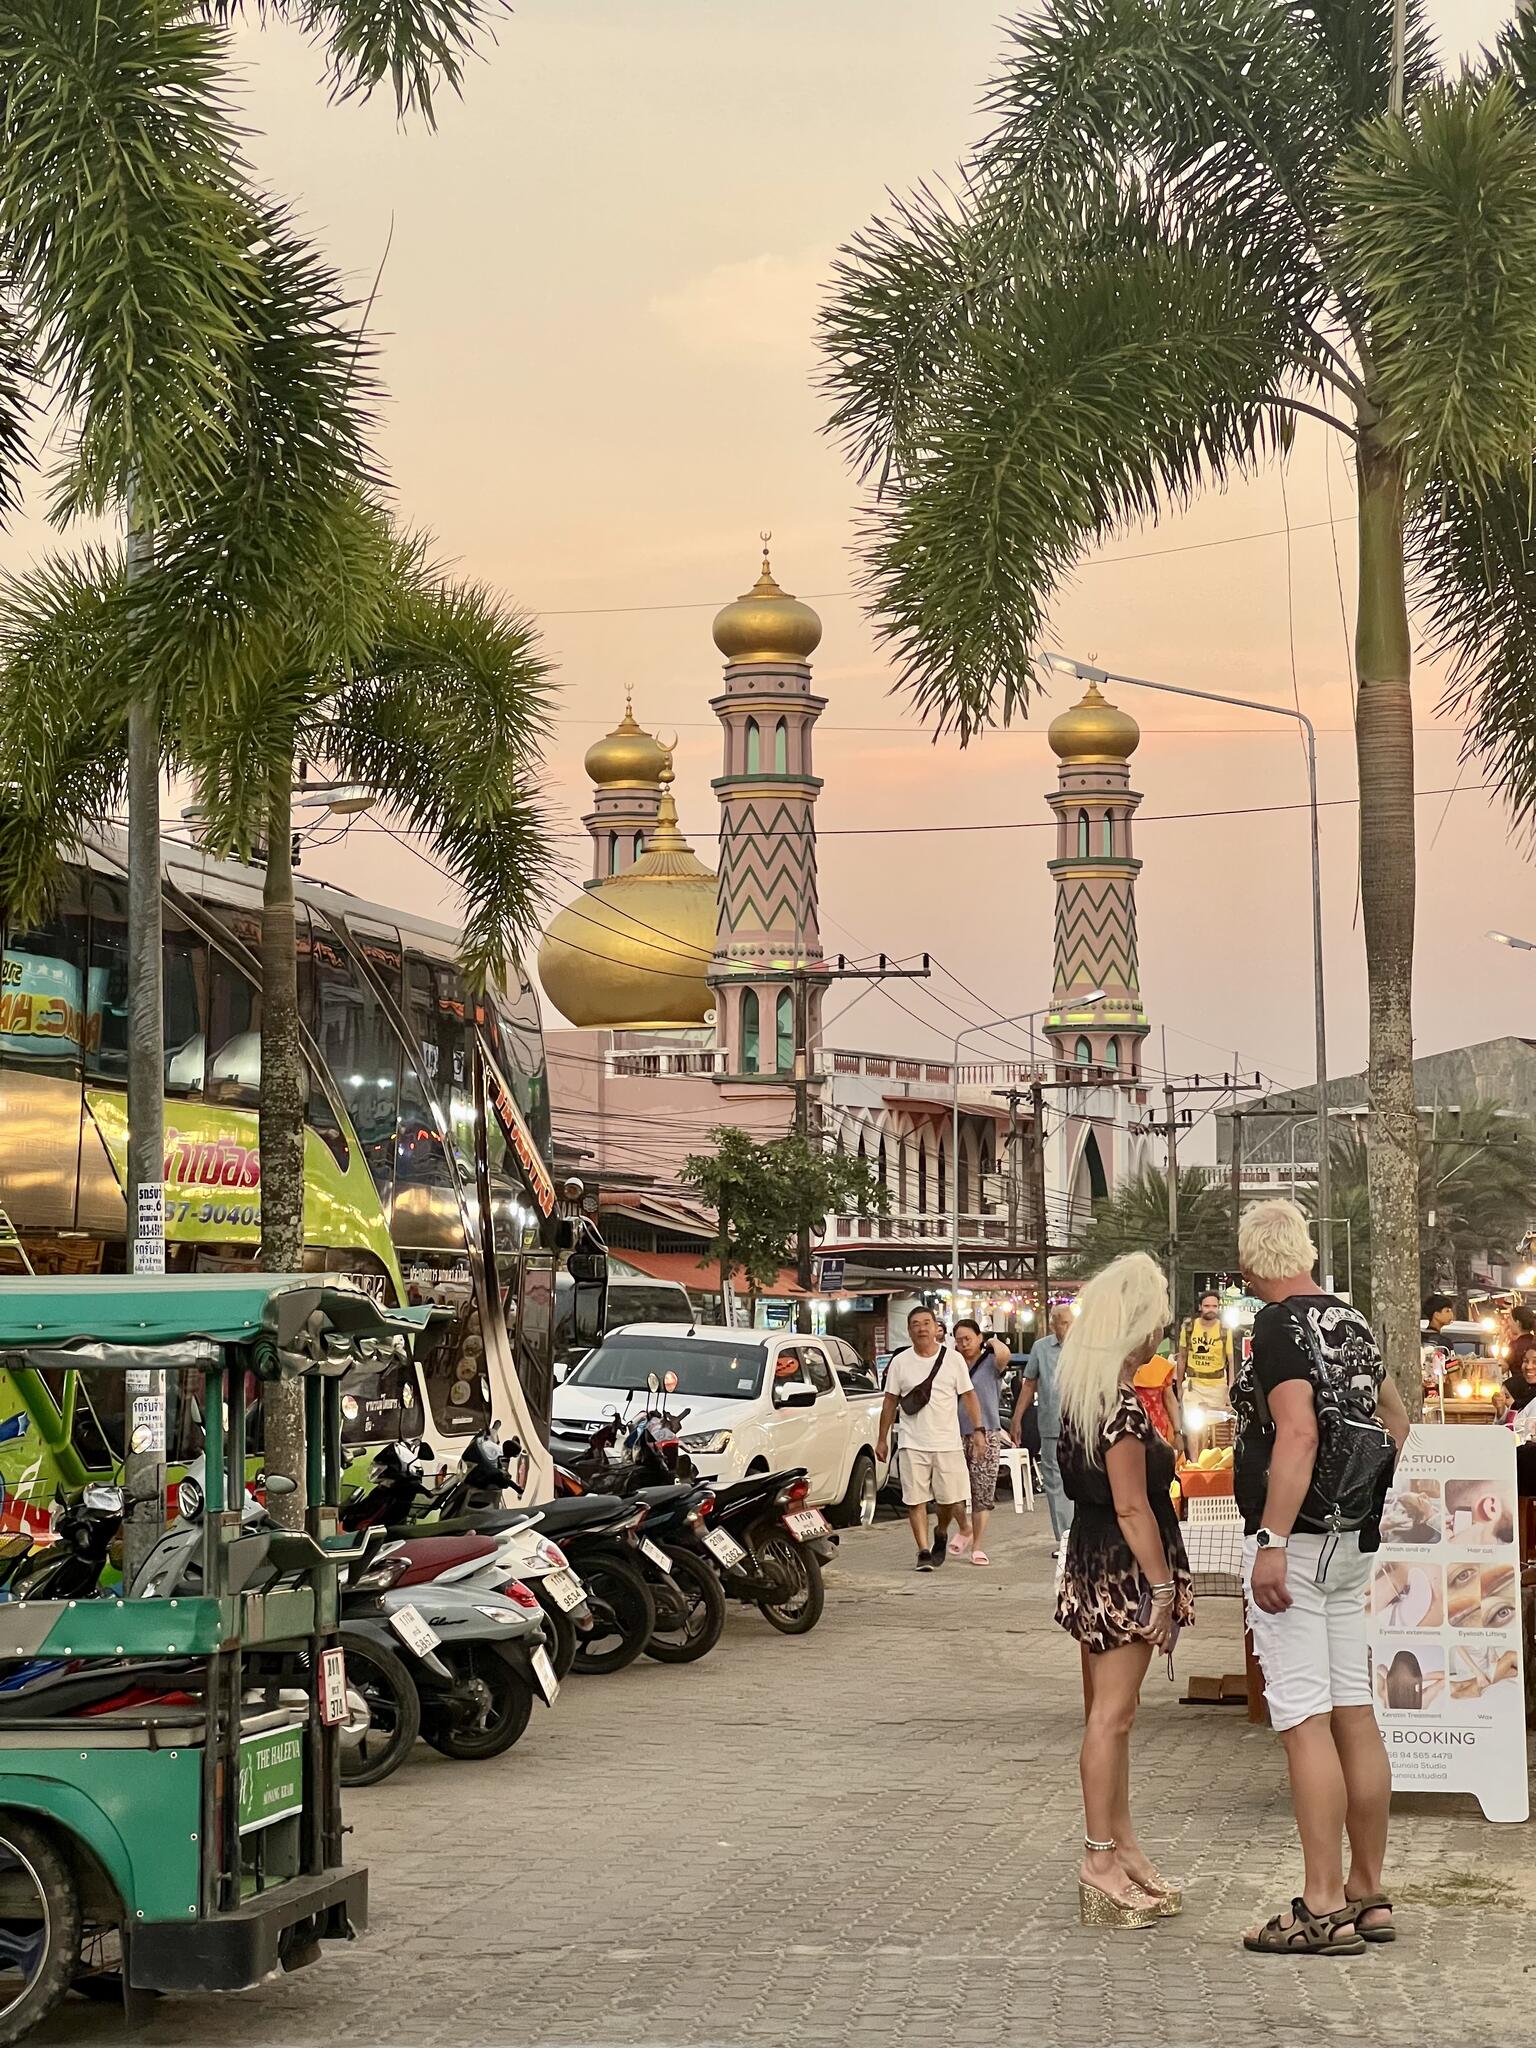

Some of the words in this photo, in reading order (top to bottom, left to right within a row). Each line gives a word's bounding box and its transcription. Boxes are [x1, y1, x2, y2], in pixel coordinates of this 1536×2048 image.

[1411, 1454, 1456, 1464] STUDIO
[563, 1590, 582, 1607] 9534
[1392, 1730, 1476, 1745] BOOKING
[256, 1748, 271, 1770] THE
[1420, 1762, 1447, 1770] Studio
